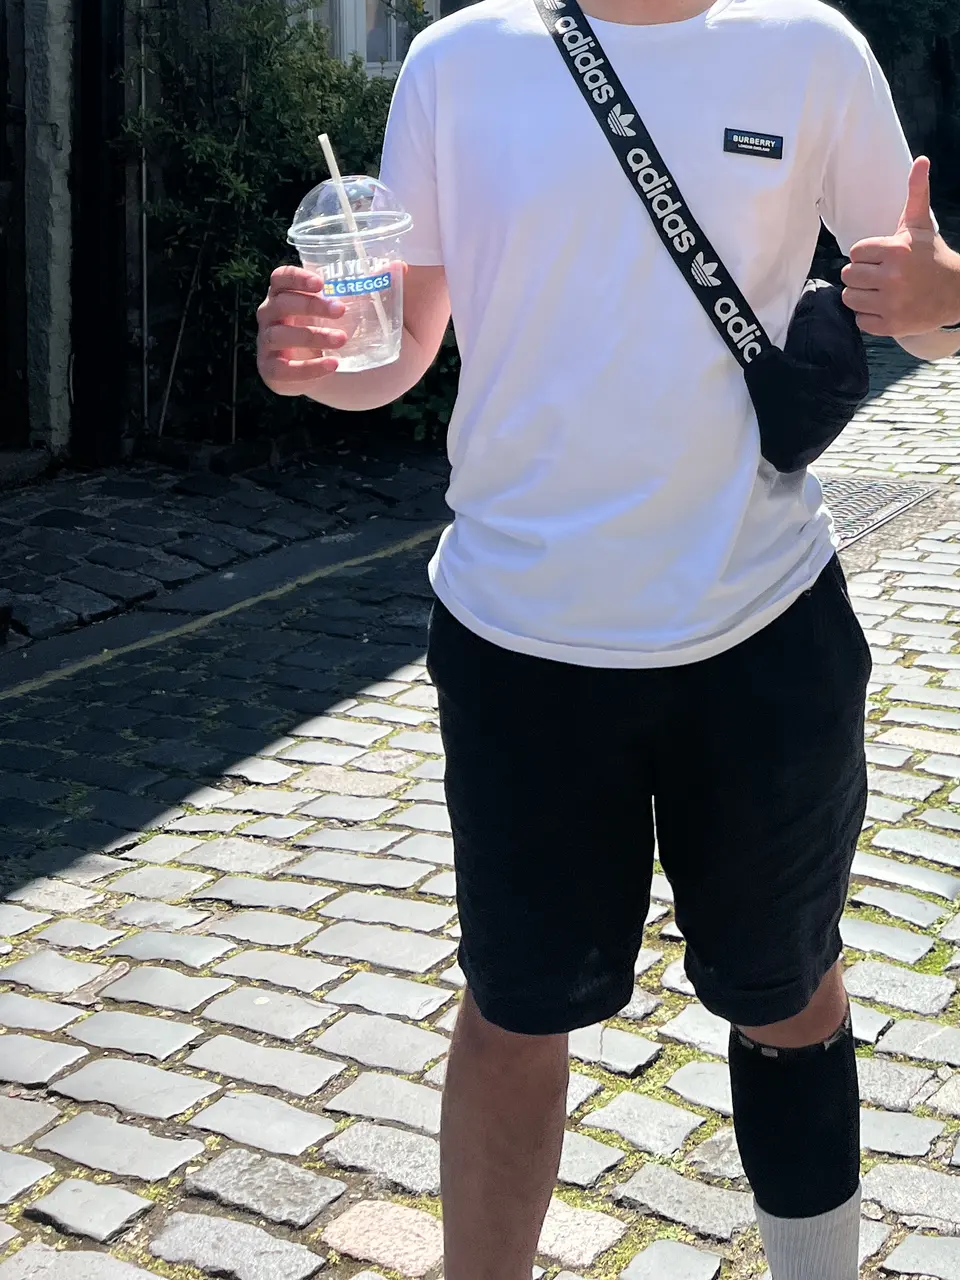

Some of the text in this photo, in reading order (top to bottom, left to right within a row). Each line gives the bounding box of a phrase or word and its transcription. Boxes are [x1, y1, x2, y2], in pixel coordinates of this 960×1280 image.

[555, 16, 615, 104] adidas
[733, 135, 775, 147] BURBERRY
[626, 147, 696, 253] adidas
[336, 275, 389, 294] GREGGS
